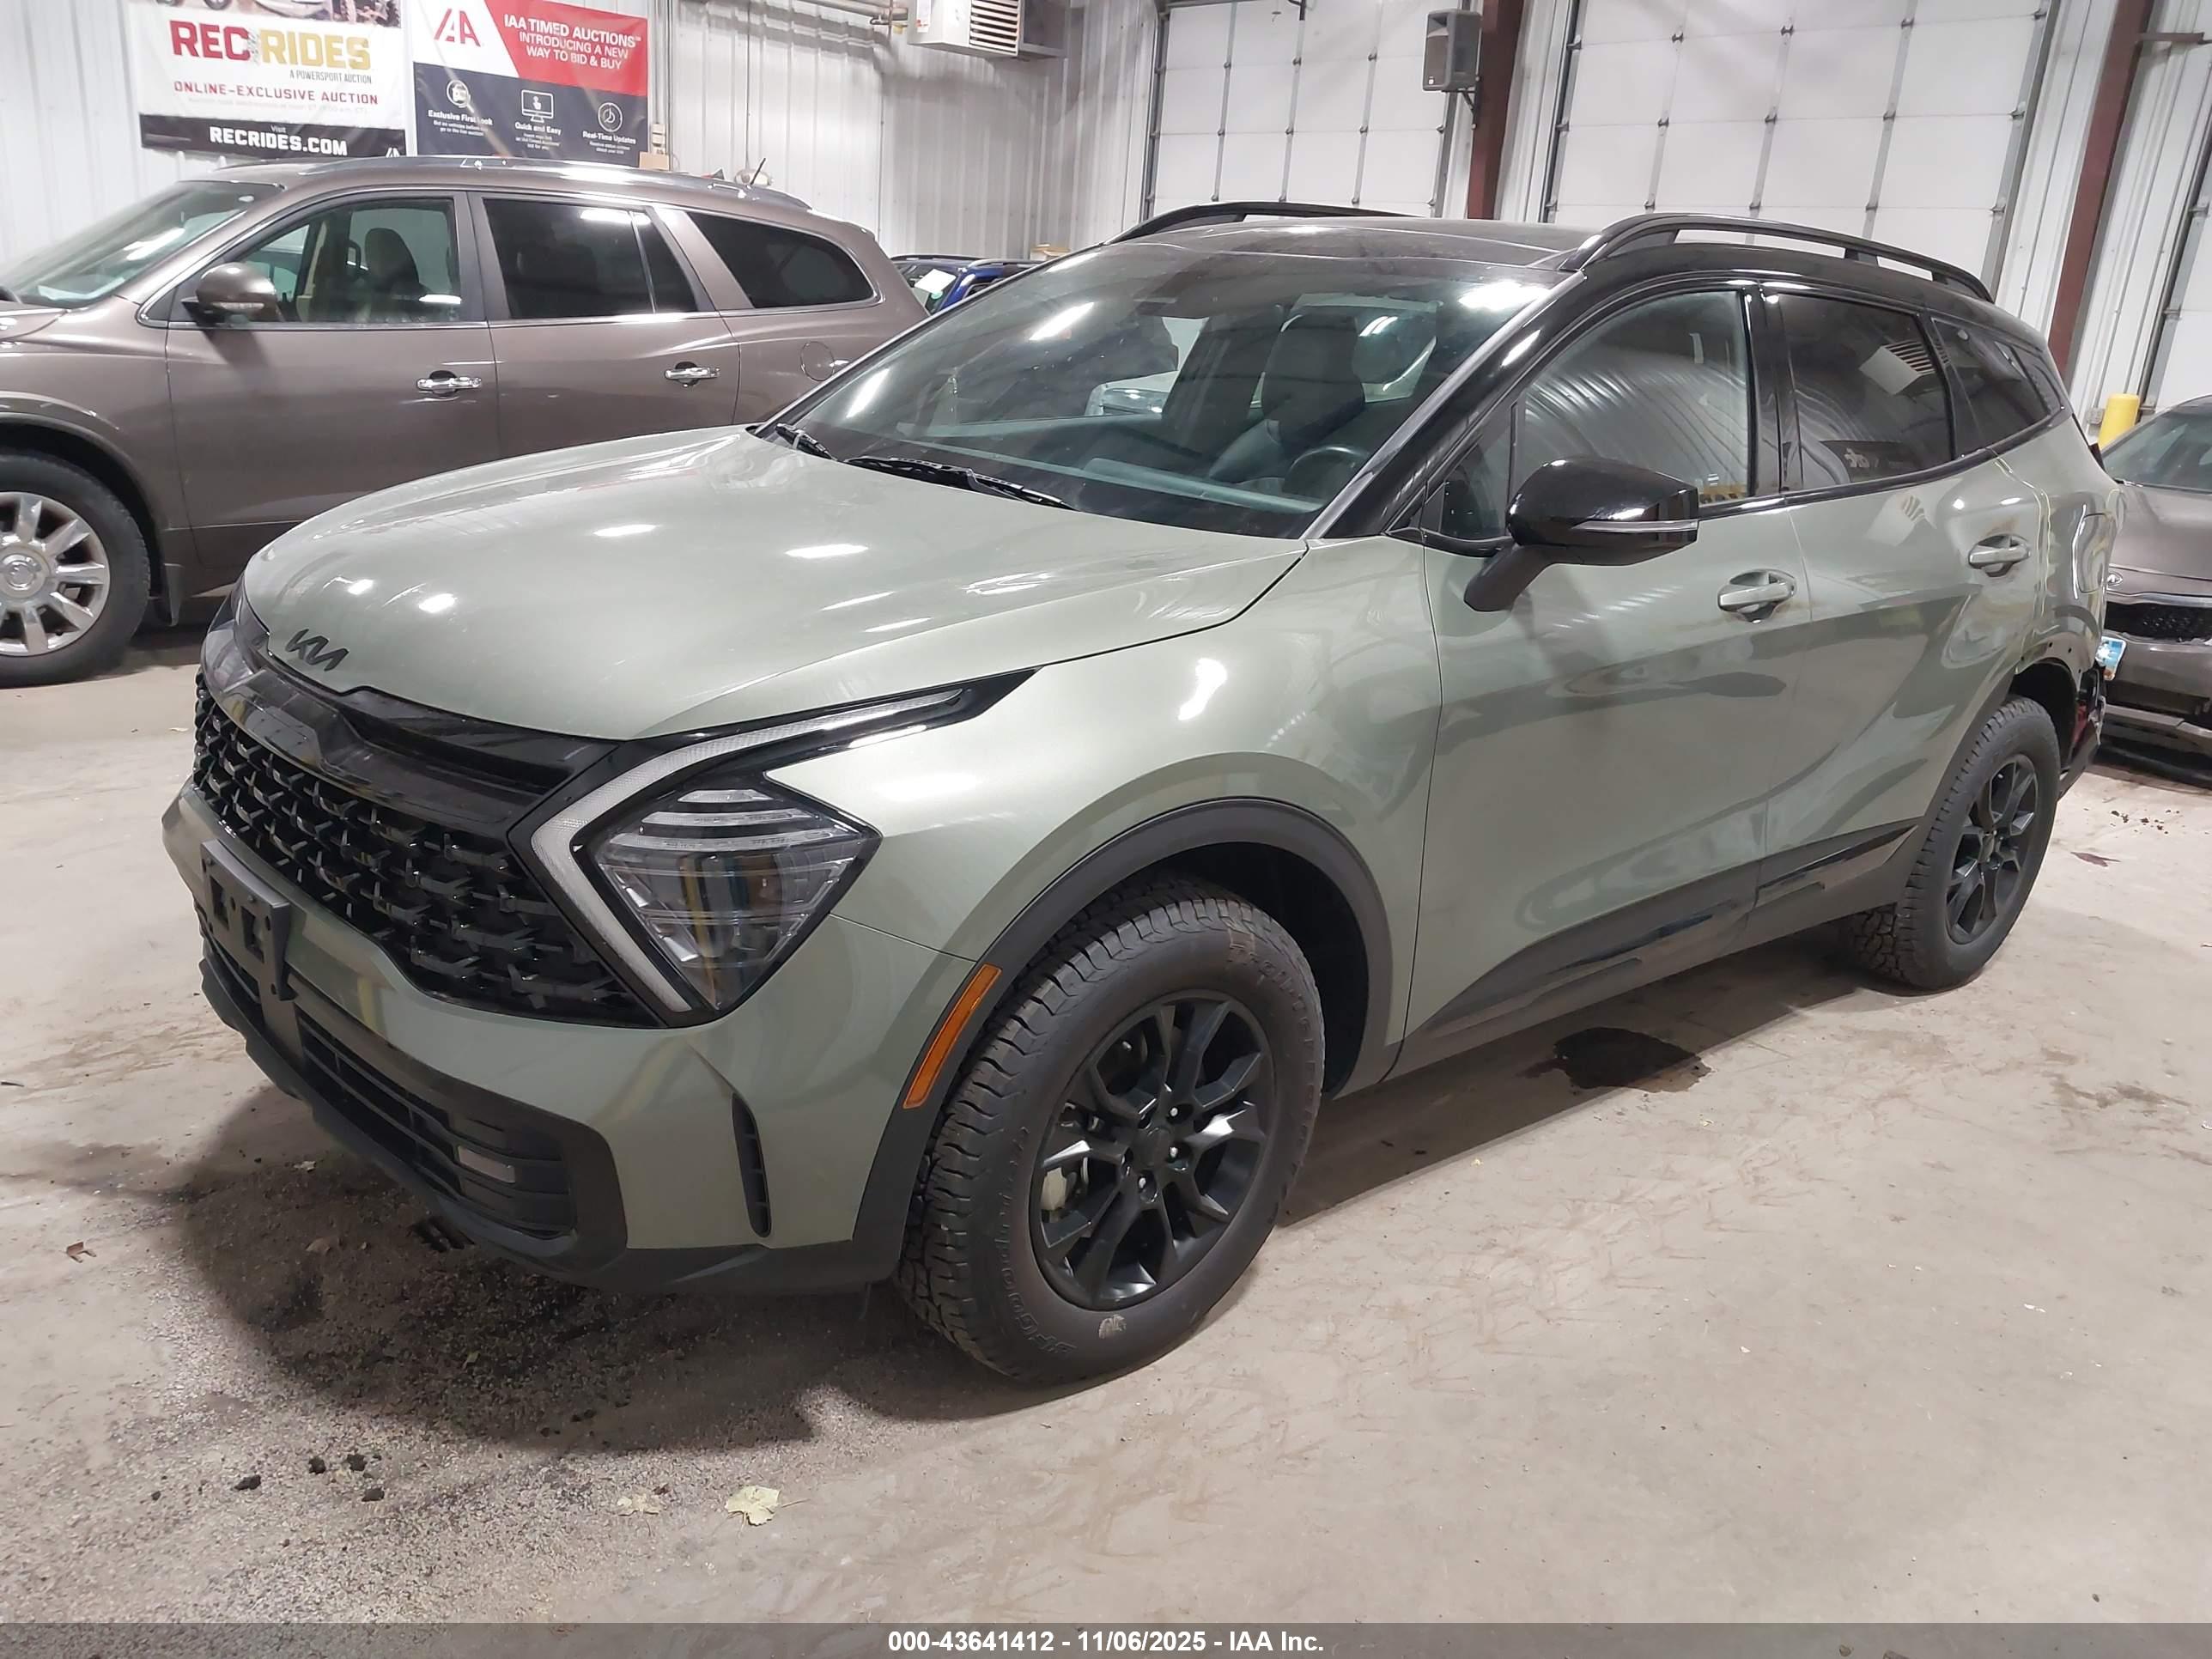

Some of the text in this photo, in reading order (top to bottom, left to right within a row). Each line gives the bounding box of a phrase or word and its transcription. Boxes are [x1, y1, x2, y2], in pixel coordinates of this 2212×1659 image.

[503, 14, 527, 29] IAA
[528, 18, 569, 37] TIMED
[520, 31, 629, 59] INTRODUCING A NEW
[526, 45, 623, 70] WAY TO BID & BUY
[173, 80, 379, 105] ONLINE-EXCLUSIVE AUCTION
[428, 109, 460, 122] Exclusive
[209, 126, 349, 156] RECRIDES.COM
[514, 121, 532, 132] Quick
[533, 124, 545, 133] and
[546, 126, 562, 137] Easy
[582, 130, 612, 141] Real-Time
[613, 134, 637, 146] Updates
